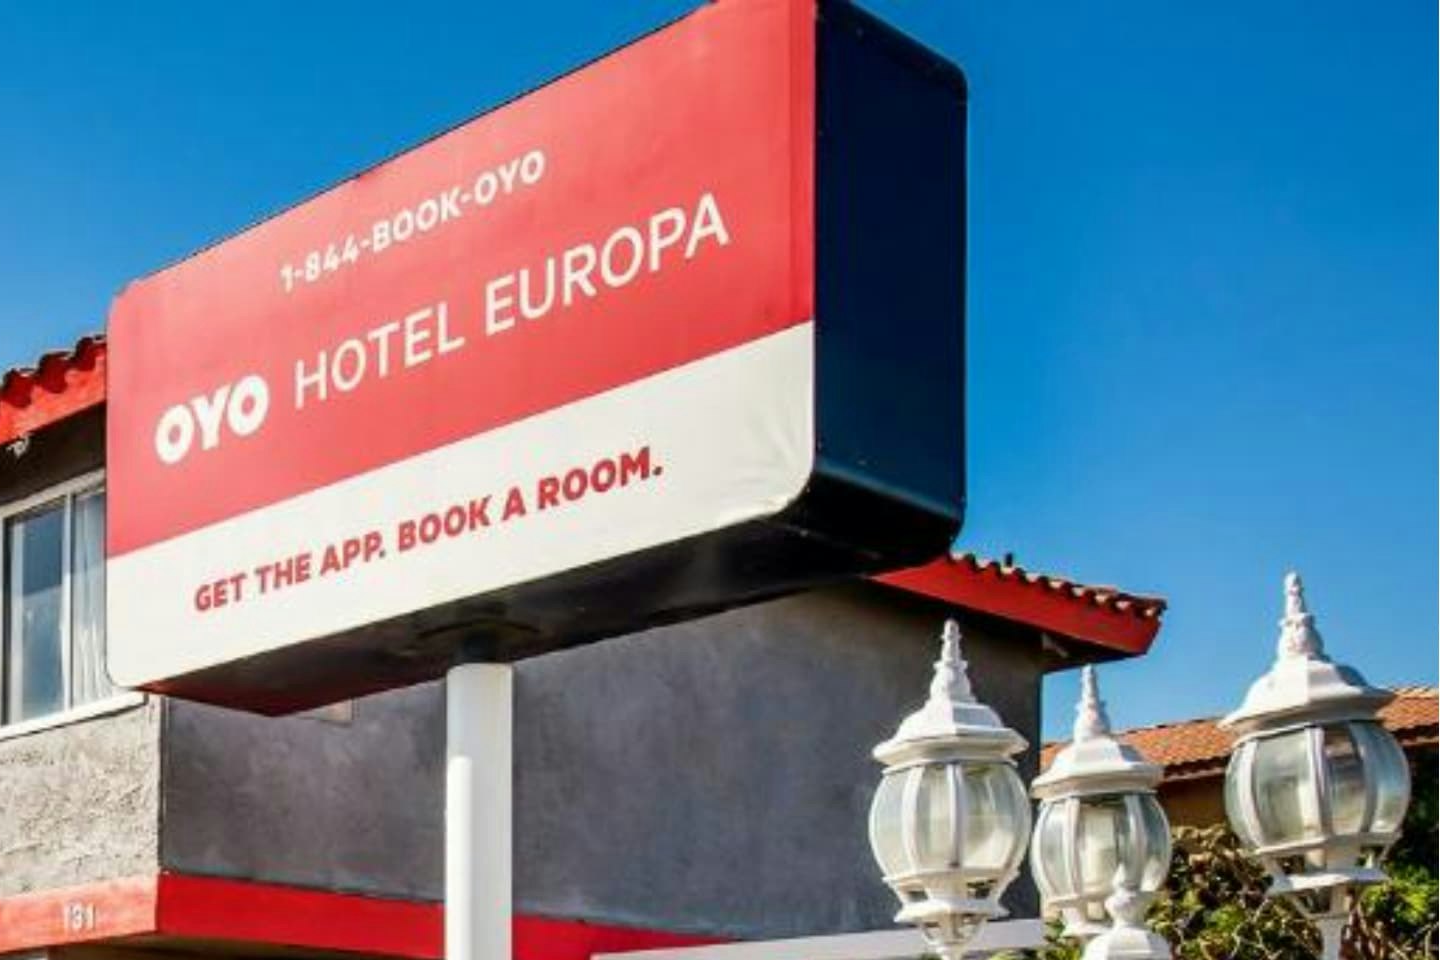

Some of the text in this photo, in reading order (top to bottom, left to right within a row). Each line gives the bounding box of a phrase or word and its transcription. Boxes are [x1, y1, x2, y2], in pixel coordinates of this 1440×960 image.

[279, 150, 546, 292] 1-844-BOOK-OYO
[155, 193, 731, 463] OYO HOTEL EUROPA
[194, 447, 664, 613] GET THE APP. BOOK A ROOM.
[63, 903, 94, 930] 131
